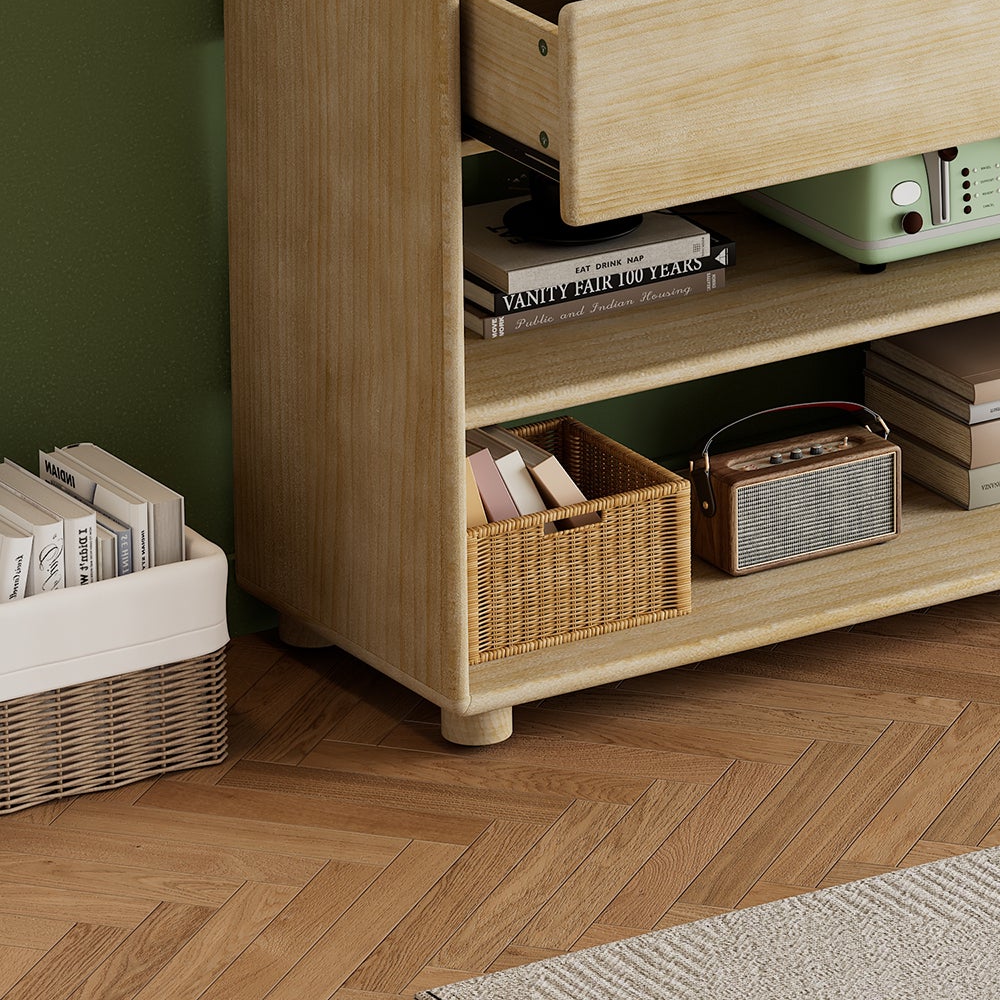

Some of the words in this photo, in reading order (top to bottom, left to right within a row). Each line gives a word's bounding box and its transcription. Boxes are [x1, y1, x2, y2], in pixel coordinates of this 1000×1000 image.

[502, 283, 568, 312] VANITY
[574, 274, 613, 298] FAIR
[617, 267, 645, 288] 100
[648, 257, 703, 282] YEARS
[575, 265, 591, 275] EAT
[595, 258, 622, 271] DRINK
[626, 254, 645, 264] NAP
[514, 313, 554, 330] Public
[559, 304, 586, 322] and
[589, 299, 636, 315] Indian
[639, 284, 692, 304] Housing
